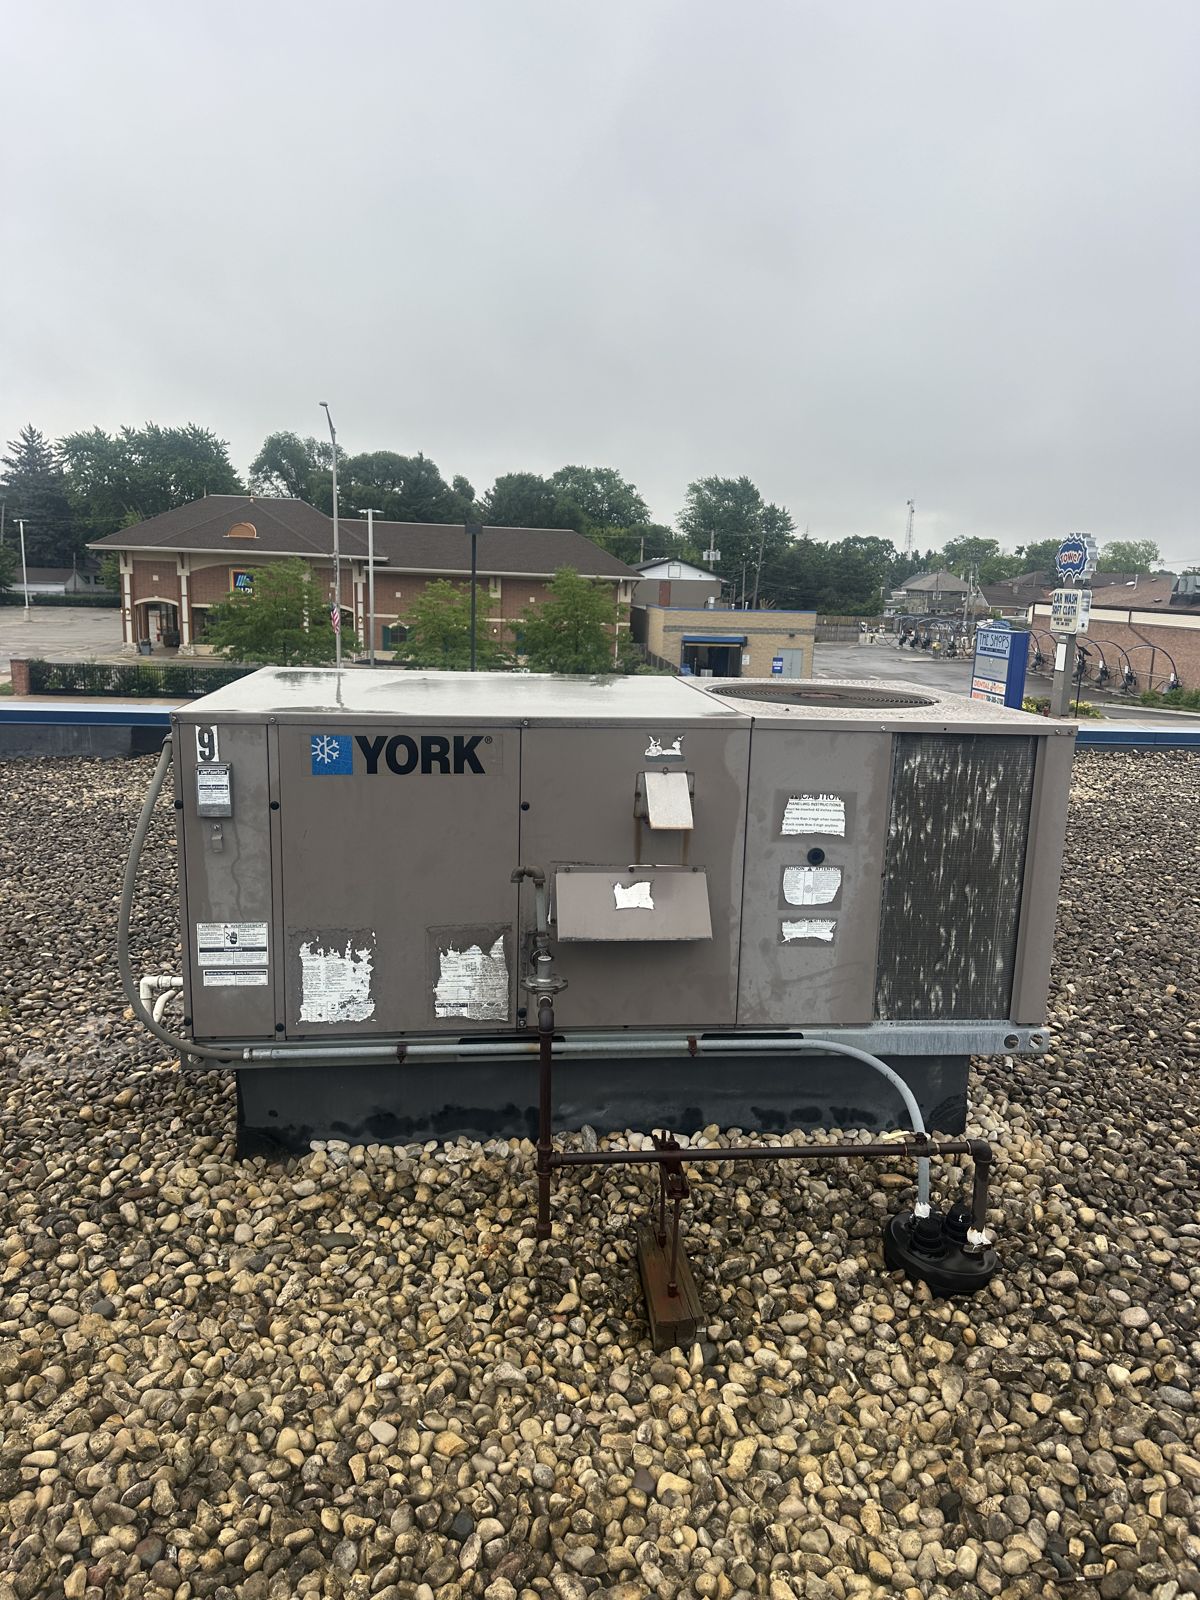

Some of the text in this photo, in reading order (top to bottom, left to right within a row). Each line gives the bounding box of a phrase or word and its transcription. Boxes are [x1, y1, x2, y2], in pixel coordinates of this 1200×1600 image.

[1054, 593, 1078, 605] CAR WASH
[1052, 605, 1077, 616] SOFT CLOTH
[979, 632, 1010, 649] THE SHOPS
[198, 725, 215, 761] 9
